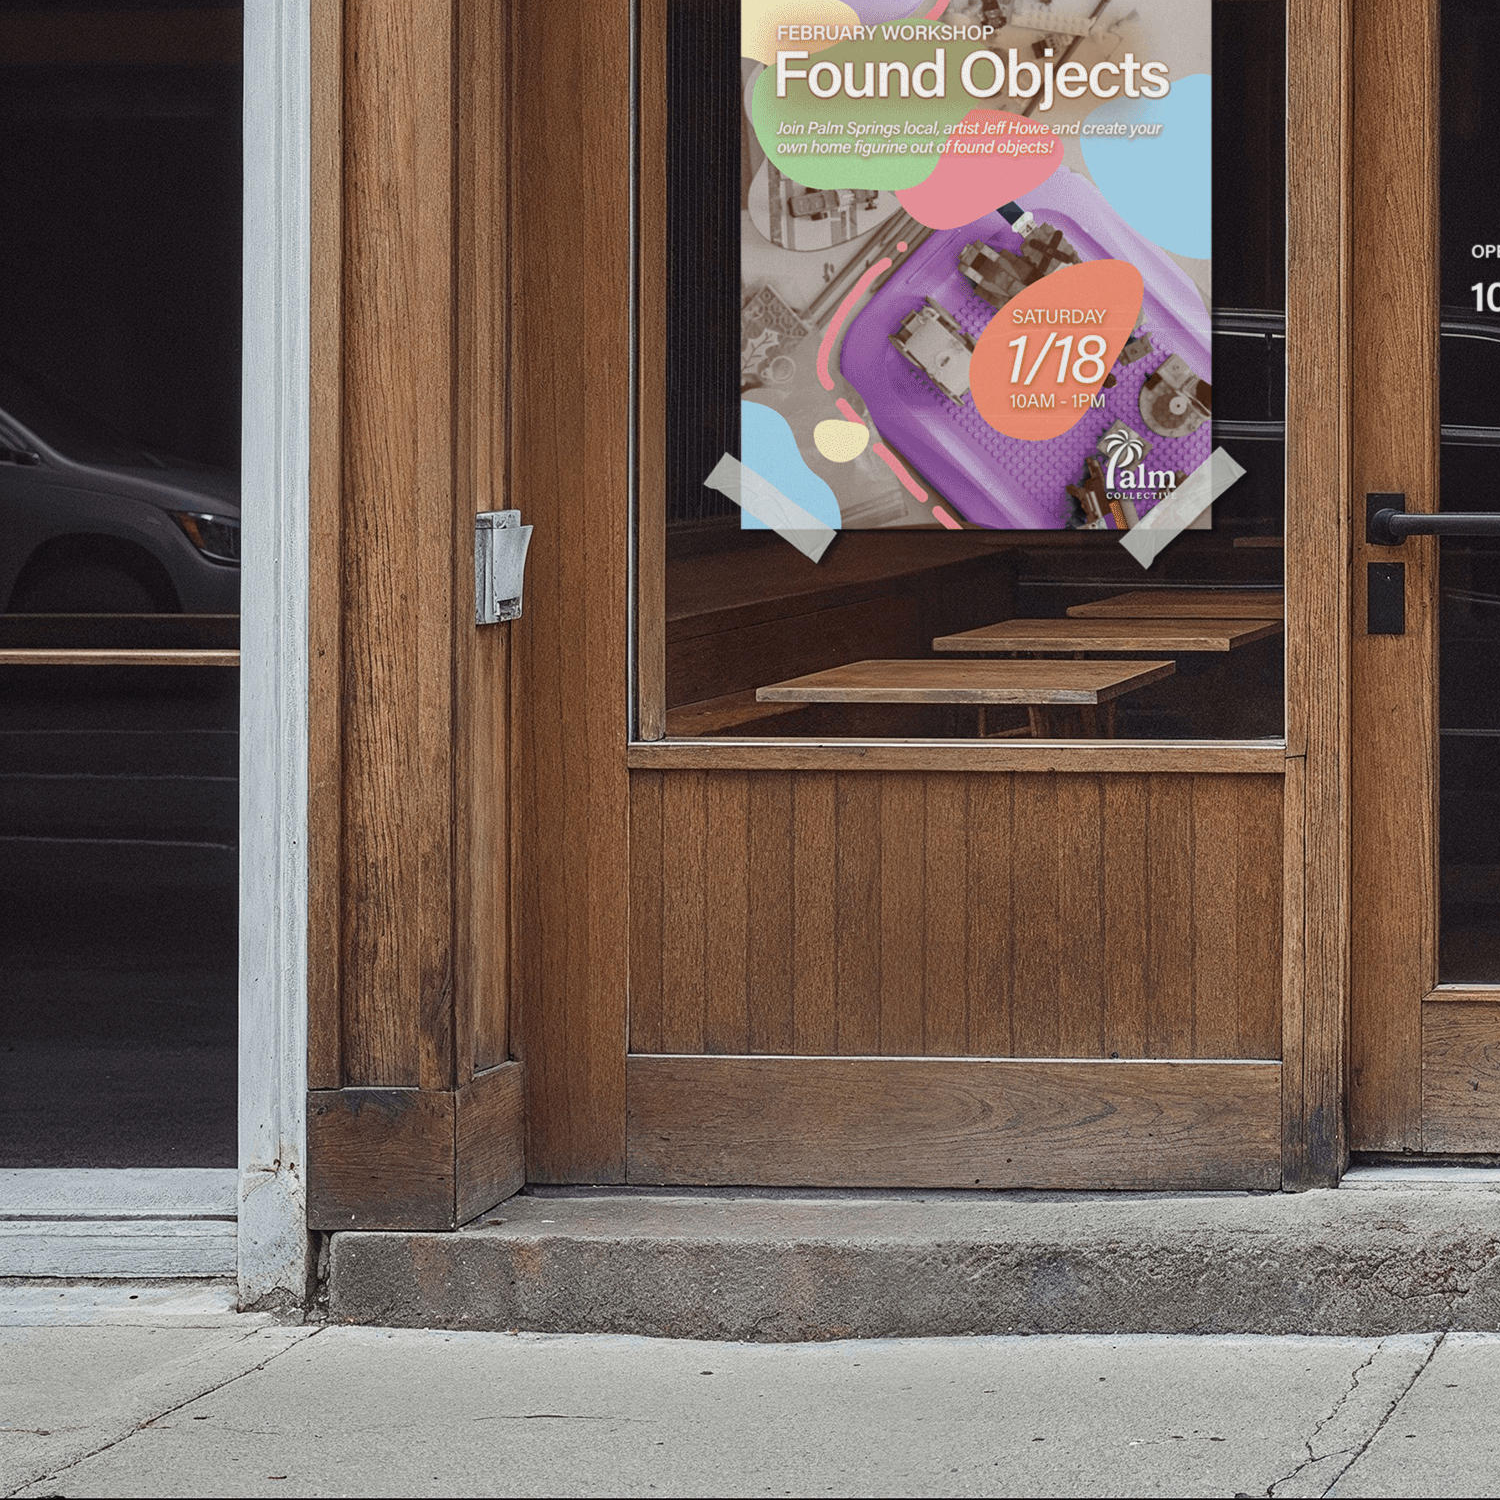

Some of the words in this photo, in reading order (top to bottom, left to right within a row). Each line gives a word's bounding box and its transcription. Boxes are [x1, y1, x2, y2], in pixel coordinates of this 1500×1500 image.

[777, 24, 877, 41] FEBRUARY
[881, 24, 995, 41] WORKSHOP
[776, 47, 946, 99] Found
[960, 47, 1171, 111] Objects
[776, 120, 805, 135] Join
[807, 120, 844, 135] Palm
[846, 120, 901, 138] Springs
[903, 120, 941, 137] local,
[943, 121, 979, 135] artist
[980, 121, 1007, 135] Jeff
[1008, 121, 1049, 135] Howe
[1051, 121, 1081, 135] and
[1082, 122, 1127, 135] create
[1128, 124, 1163, 138] your
[777, 141, 809, 154] own
[810, 140, 852, 154] home
[853, 140, 907, 157] figurine
[909, 140, 935, 154] out
[936, 140, 952, 154] of
[953, 140, 994, 154] found
[996, 140, 1054, 157] objects!
[1012, 309, 1107, 324] SATURDAY
[1008, 332, 1107, 386] 1/18
[1009, 393, 1055, 408] 10AM
[1071, 393, 1106, 408] 1PM
[1105, 491, 1177, 500] COLLECTIVE
